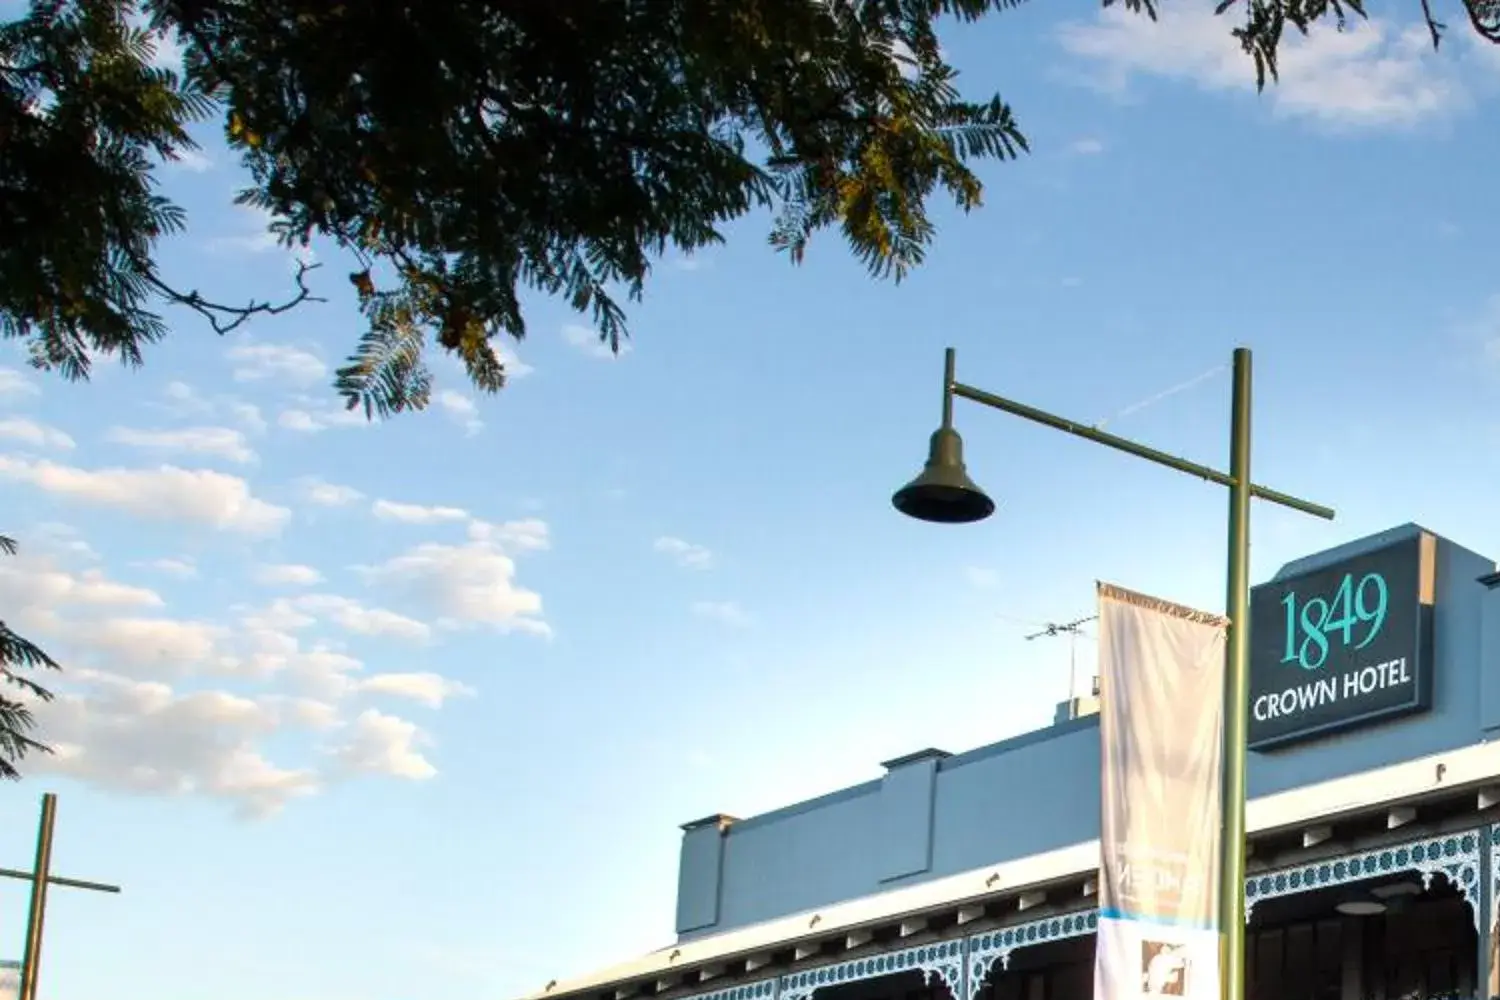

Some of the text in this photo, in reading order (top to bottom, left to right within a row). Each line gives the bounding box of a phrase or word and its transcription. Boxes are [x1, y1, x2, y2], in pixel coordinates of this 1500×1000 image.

[1280, 572, 1389, 670] 1849
[1253, 657, 1411, 721] CROWN HOTEL
